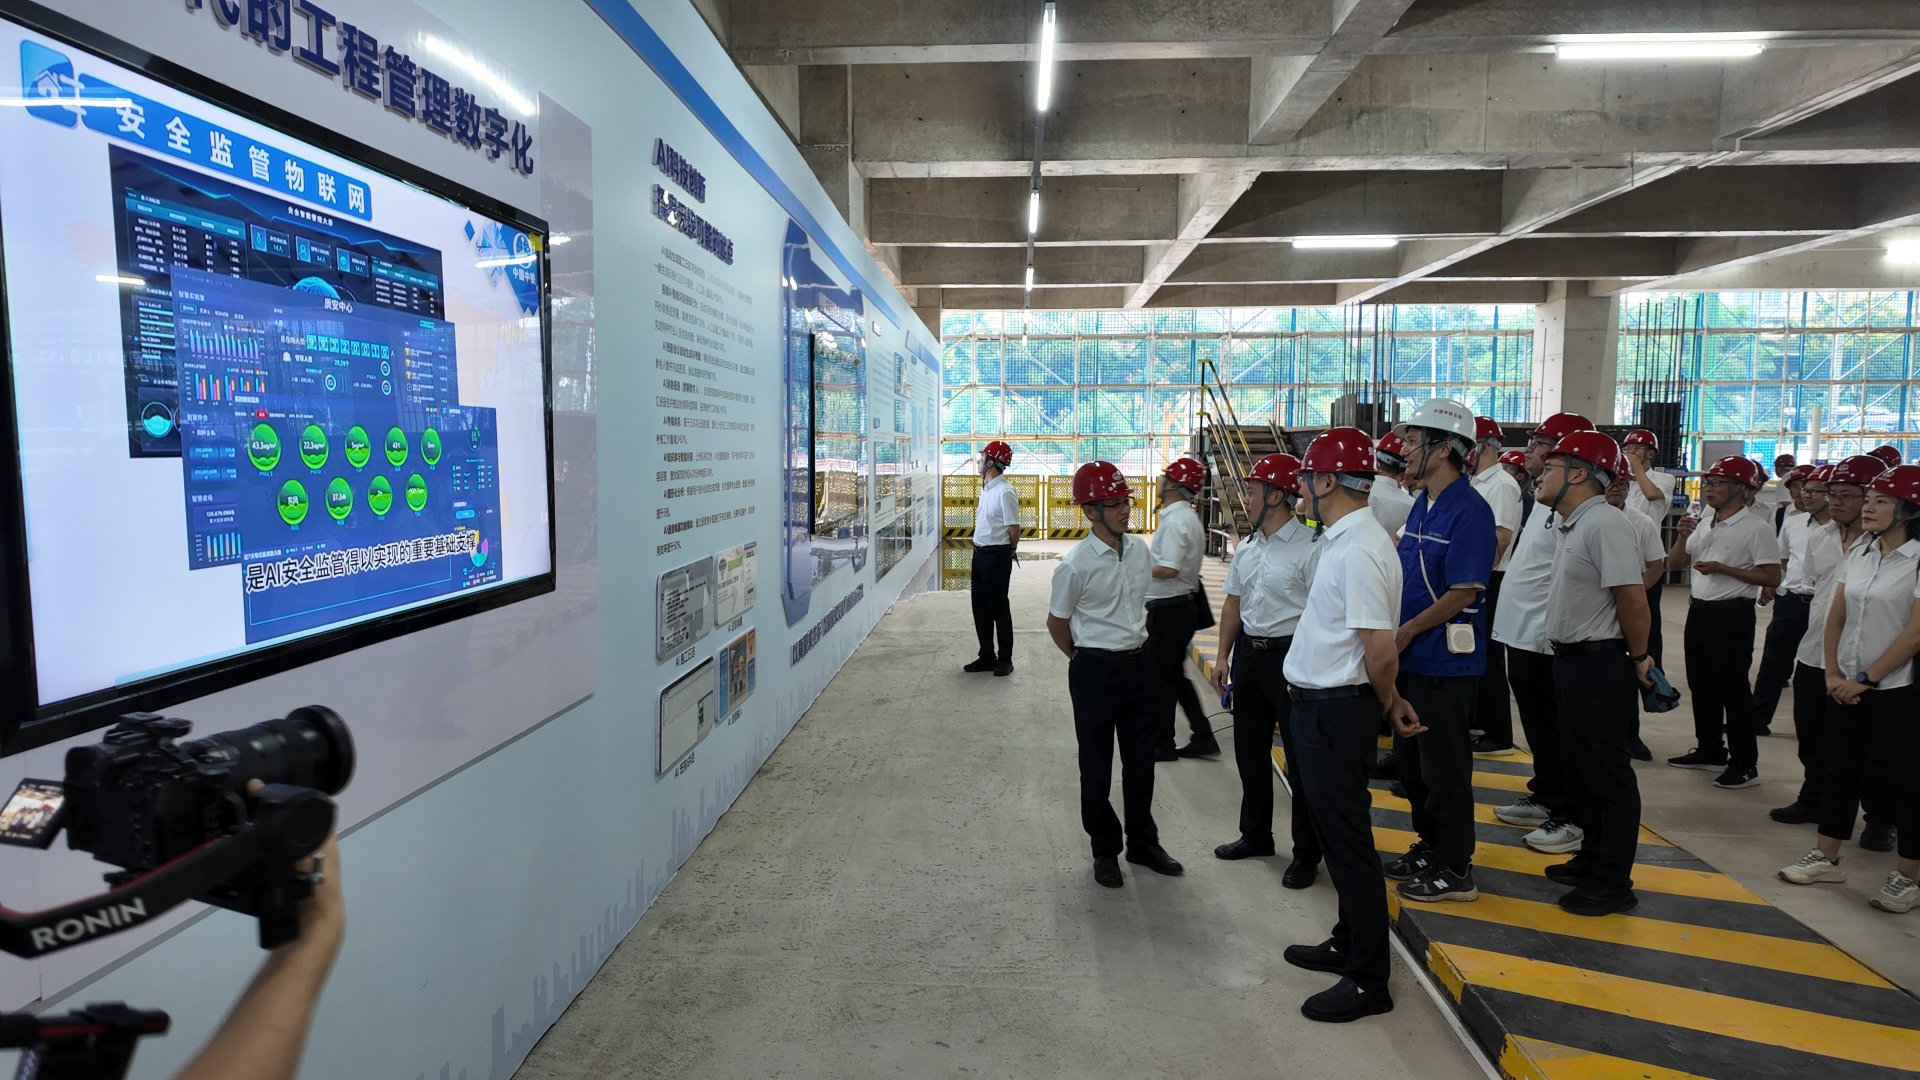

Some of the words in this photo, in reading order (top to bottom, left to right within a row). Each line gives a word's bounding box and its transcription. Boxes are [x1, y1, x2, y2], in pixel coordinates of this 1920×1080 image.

[117, 98, 367, 215] 安全监管物联网
[512, 266, 537, 285] 中国中铁
[323, 297, 354, 314] 质安中心
[245, 530, 477, 594] 是AI安全监管得以实现的重要基础支撑
[1433, 878, 1449, 890] N
[30, 897, 148, 952] RONIN
